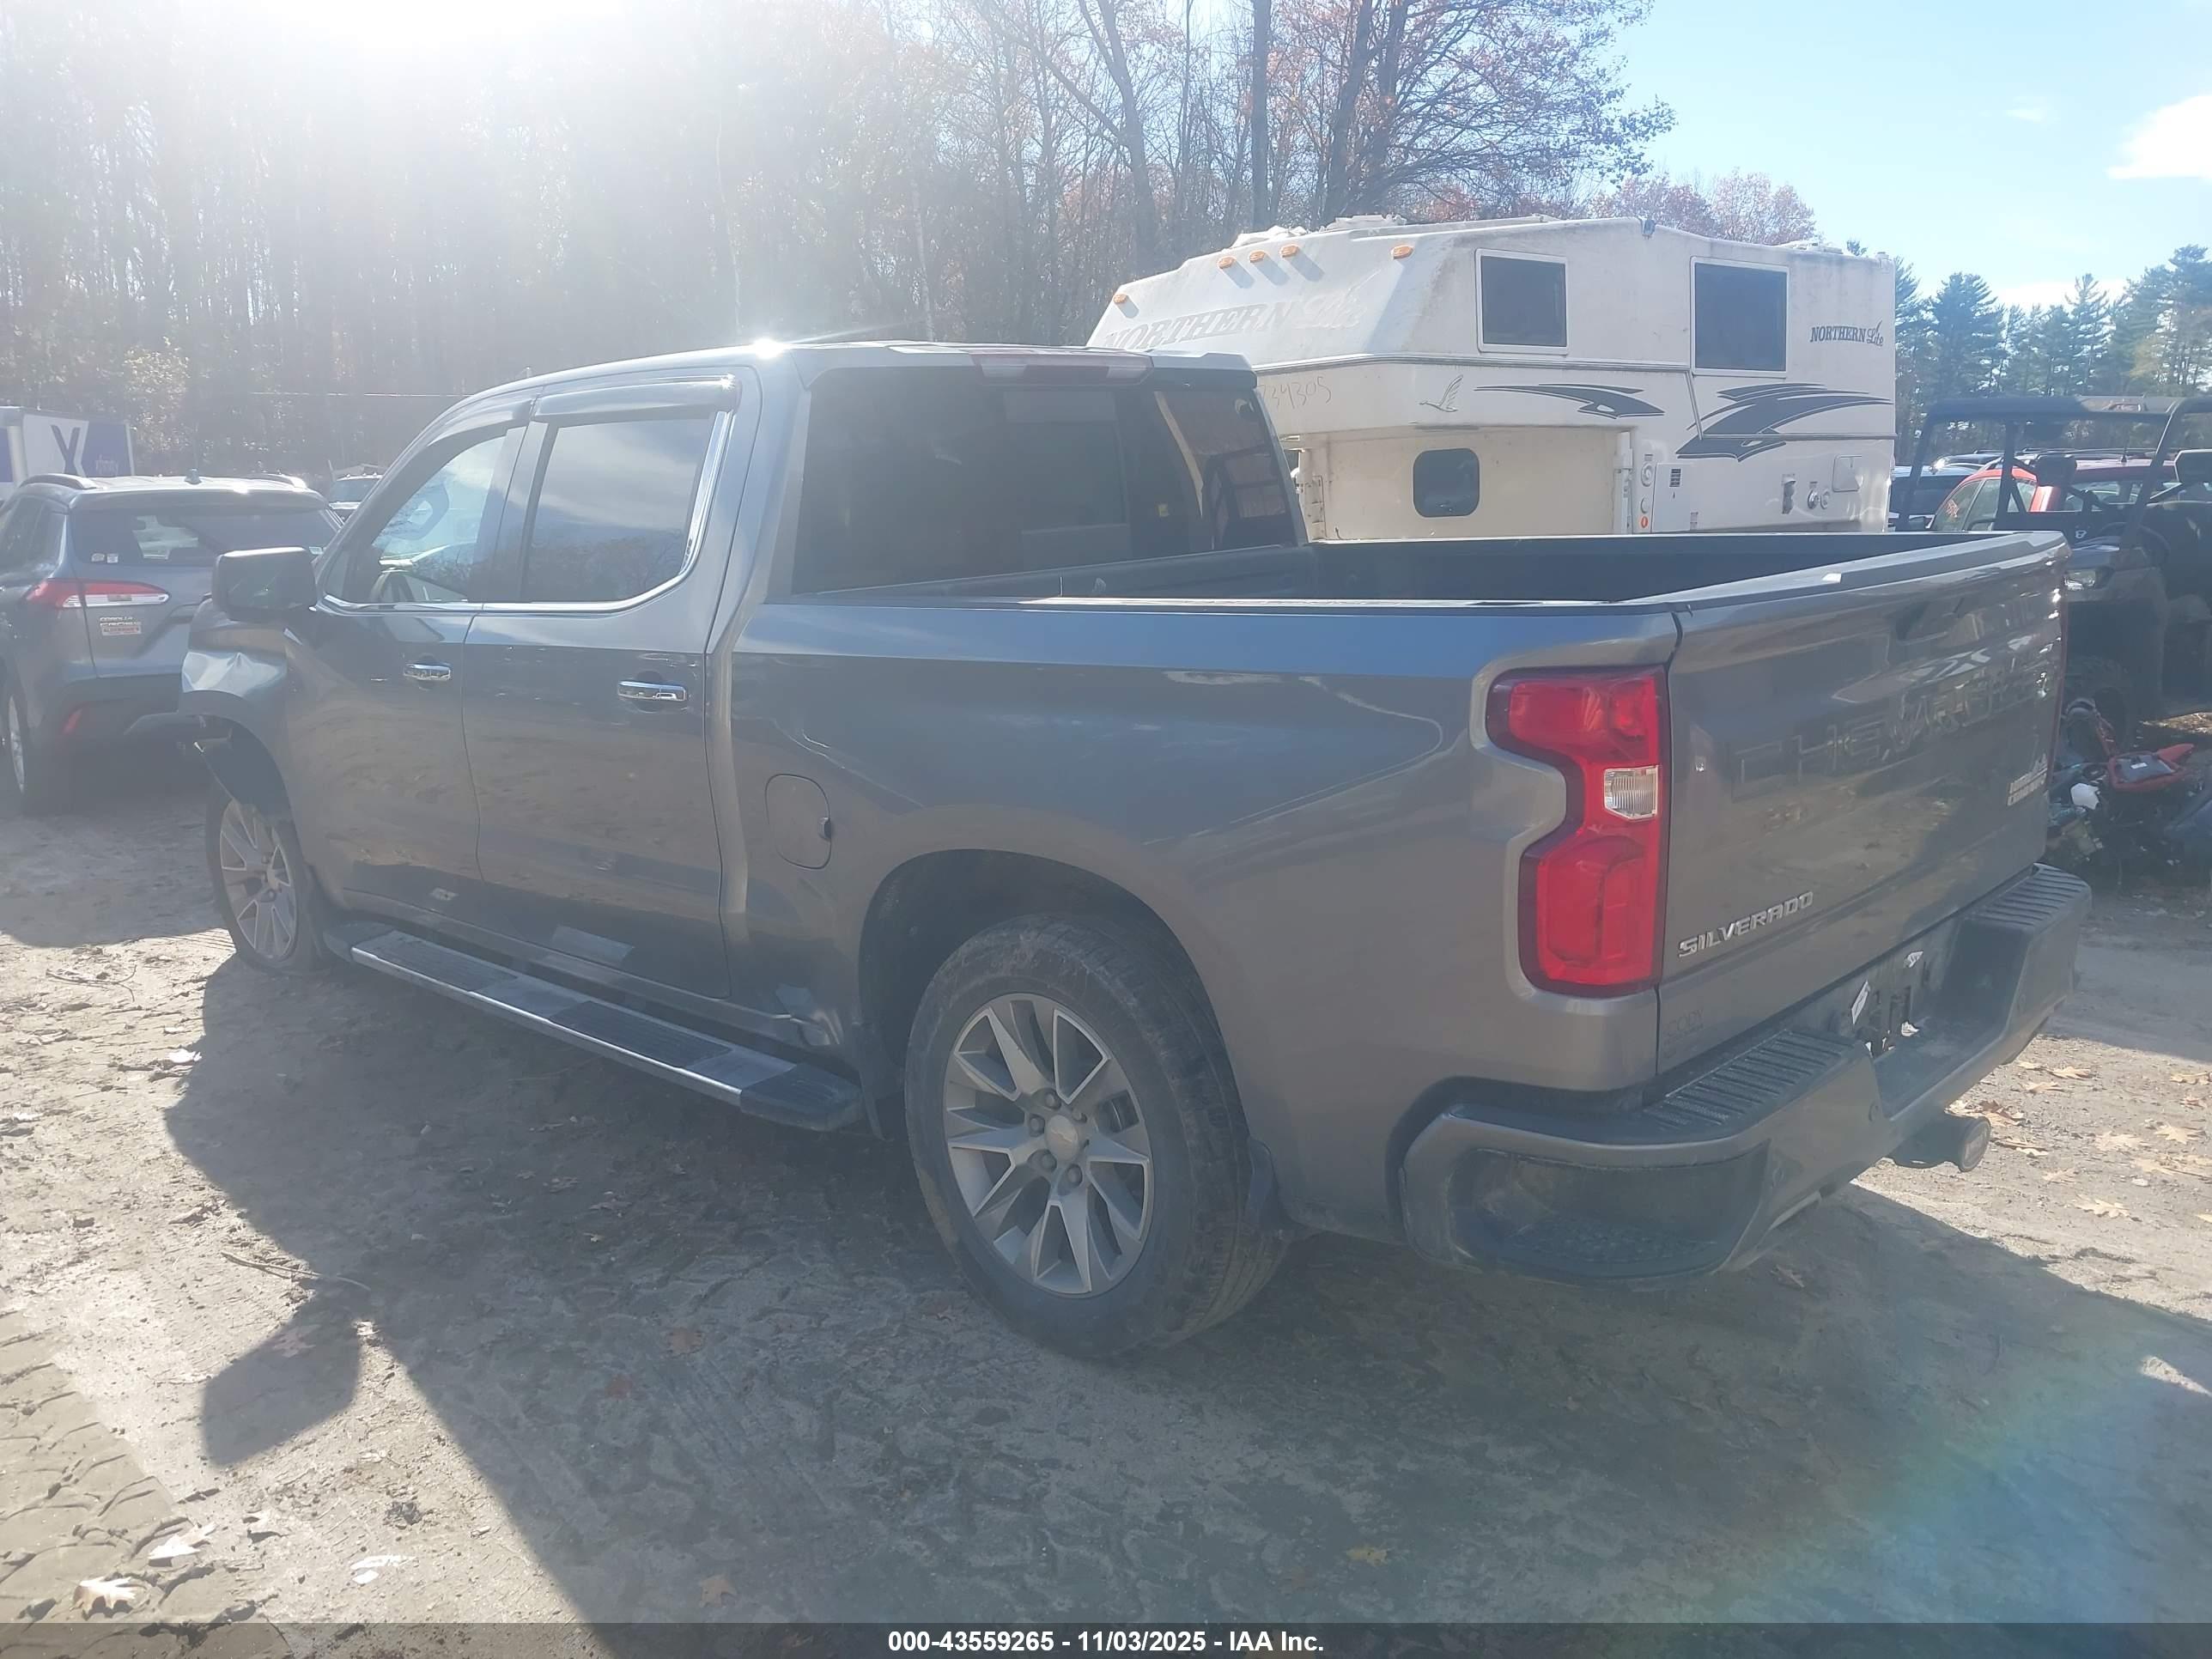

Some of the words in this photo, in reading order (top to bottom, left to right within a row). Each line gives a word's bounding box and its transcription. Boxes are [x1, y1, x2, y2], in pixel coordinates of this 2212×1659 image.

[1104, 301, 1295, 349] NORTHERN
[1809, 325, 1867, 343] NORTHERN
[1677, 890, 1814, 958] SILVERADO
